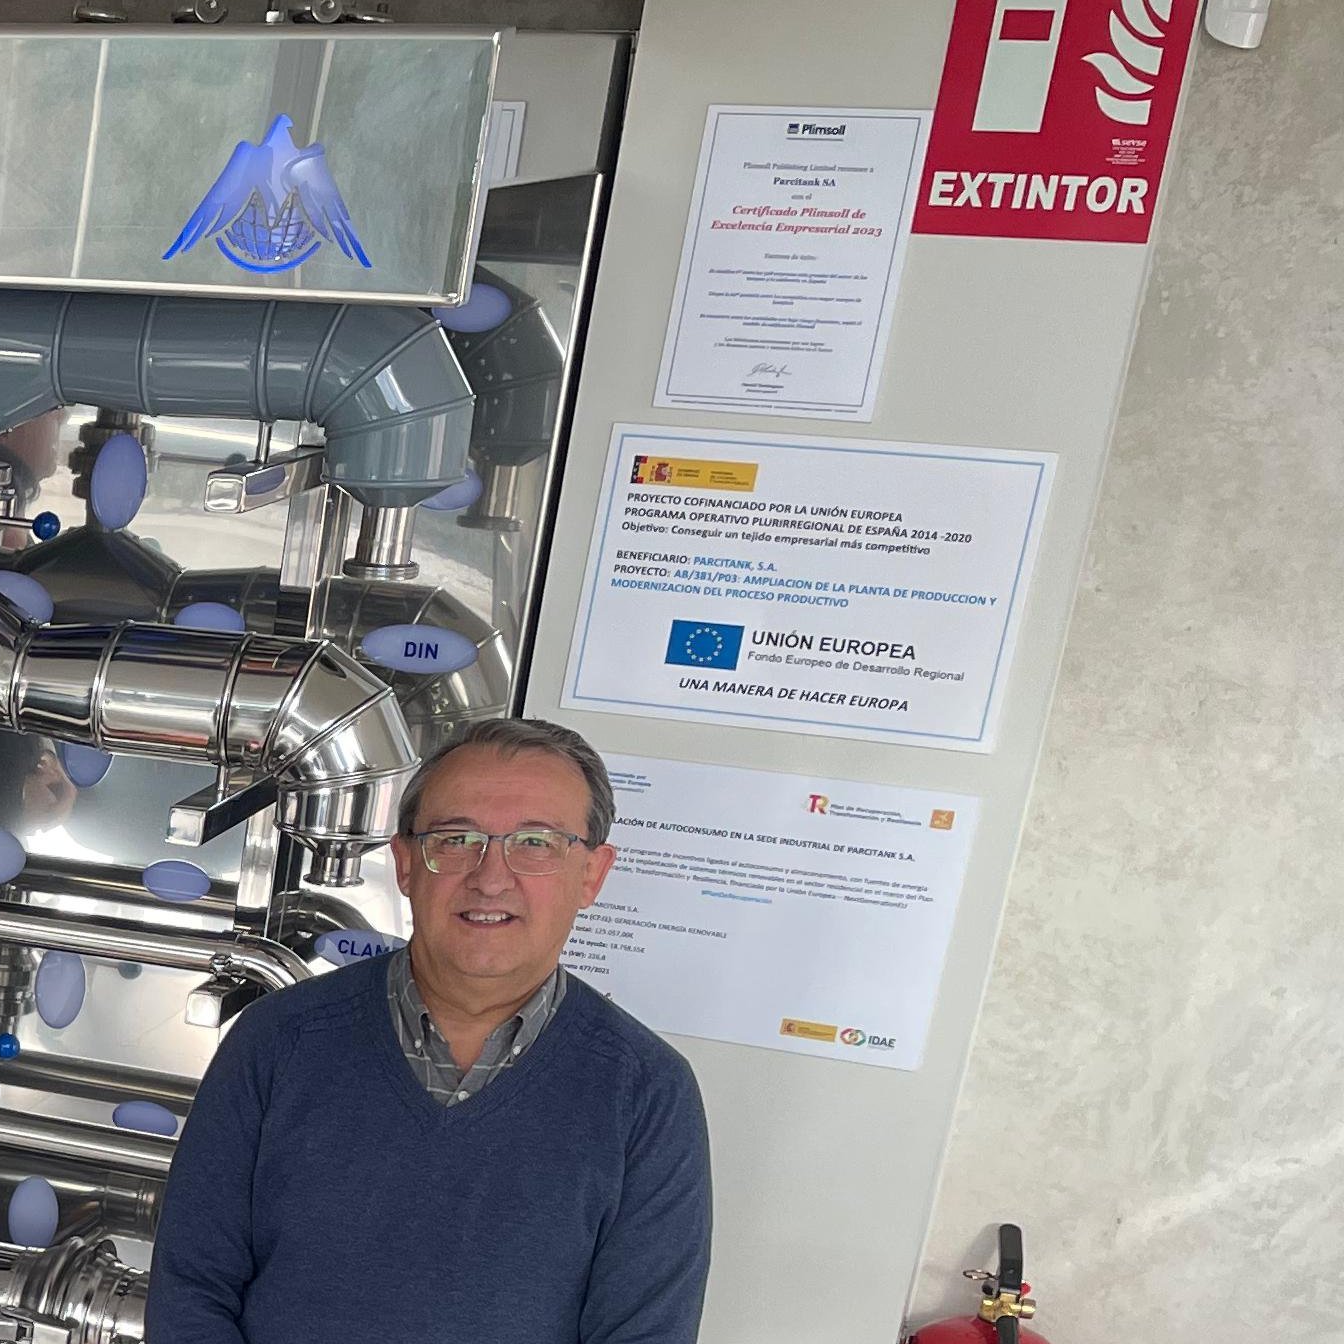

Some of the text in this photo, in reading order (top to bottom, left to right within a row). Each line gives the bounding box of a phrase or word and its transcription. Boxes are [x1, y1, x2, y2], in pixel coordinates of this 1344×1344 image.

[801, 124, 846, 136] Plimsoll
[822, 178, 836, 187] SA
[928, 171, 1148, 214] EXTINTOR
[732, 205, 867, 219] Certificado Plimsoll de
[711, 220, 883, 238] Excelencia Empresarial 2023
[627, 493, 903, 523] PROYECTO COFINANCIADO POR LA UNIÓN EUROPEA
[621, 521, 931, 556] Objetivo: Conseguir un tejido empresarial más competitivo
[624, 507, 972, 544] PROGRAMA OPERATIVO PLURIRREGIONAL DE ESPAÑA 2014 -2020
[616, 550, 777, 572] BENEFICIARIO: PARCITANK, S.A.
[611, 578, 849, 608] MODERNIZACION DEL PROCESO PRODUCTIVO
[613, 564, 671, 578] PROYECTO:
[743, 575, 812, 590] AMPLIACION
[814, 581, 830, 591] DE
[832, 583, 846, 593] LA
[848, 584, 891, 598] PLANTA
[893, 589, 908, 599] DE
[911, 590, 986, 606] PRODUCCION
[989, 597, 998, 606] Y
[404, 641, 439, 660] DIN
[752, 630, 917, 661] UNIÓN EUROPEA
[747, 651, 965, 682] Fondo Europeo de Desarrollo Regional
[679, 677, 909, 712] UNA MANERA DE HACER EUROPA
[613, 817, 644, 827] LACIÓN
[646, 820, 657, 829] DE
[659, 822, 728, 838] AUTOCONSUMO
[729, 831, 742, 839] EN
[743, 832, 754, 842] LA
[756, 835, 778, 844] SEDE
[779, 837, 831, 852] INDUSTRIAL
[833, 844, 845, 853] DE
[847, 846, 897, 861] PARCITANK
[868, 1035, 896, 1048] IDAE
